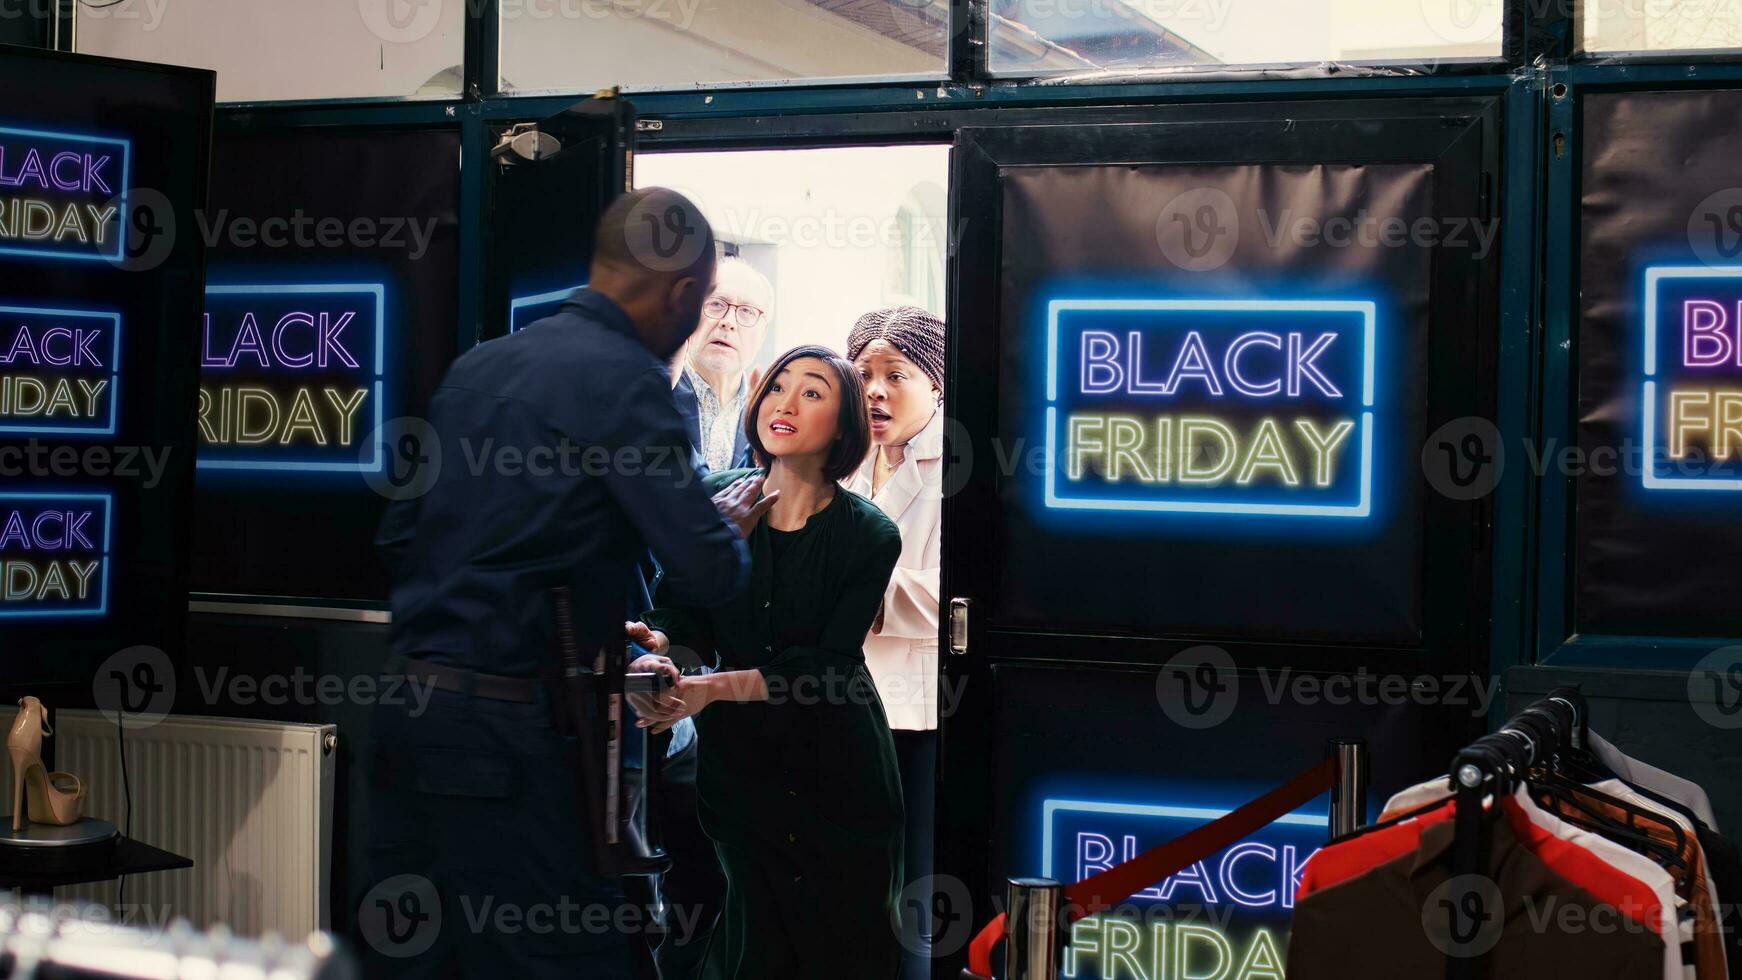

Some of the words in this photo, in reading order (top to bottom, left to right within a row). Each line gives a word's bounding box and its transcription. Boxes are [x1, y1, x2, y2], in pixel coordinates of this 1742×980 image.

[0, 325, 103, 367] ACK
[1080, 330, 1343, 398] BLACK
[1067, 415, 1355, 488] FRIDAY
[0, 560, 99, 600] DAY
